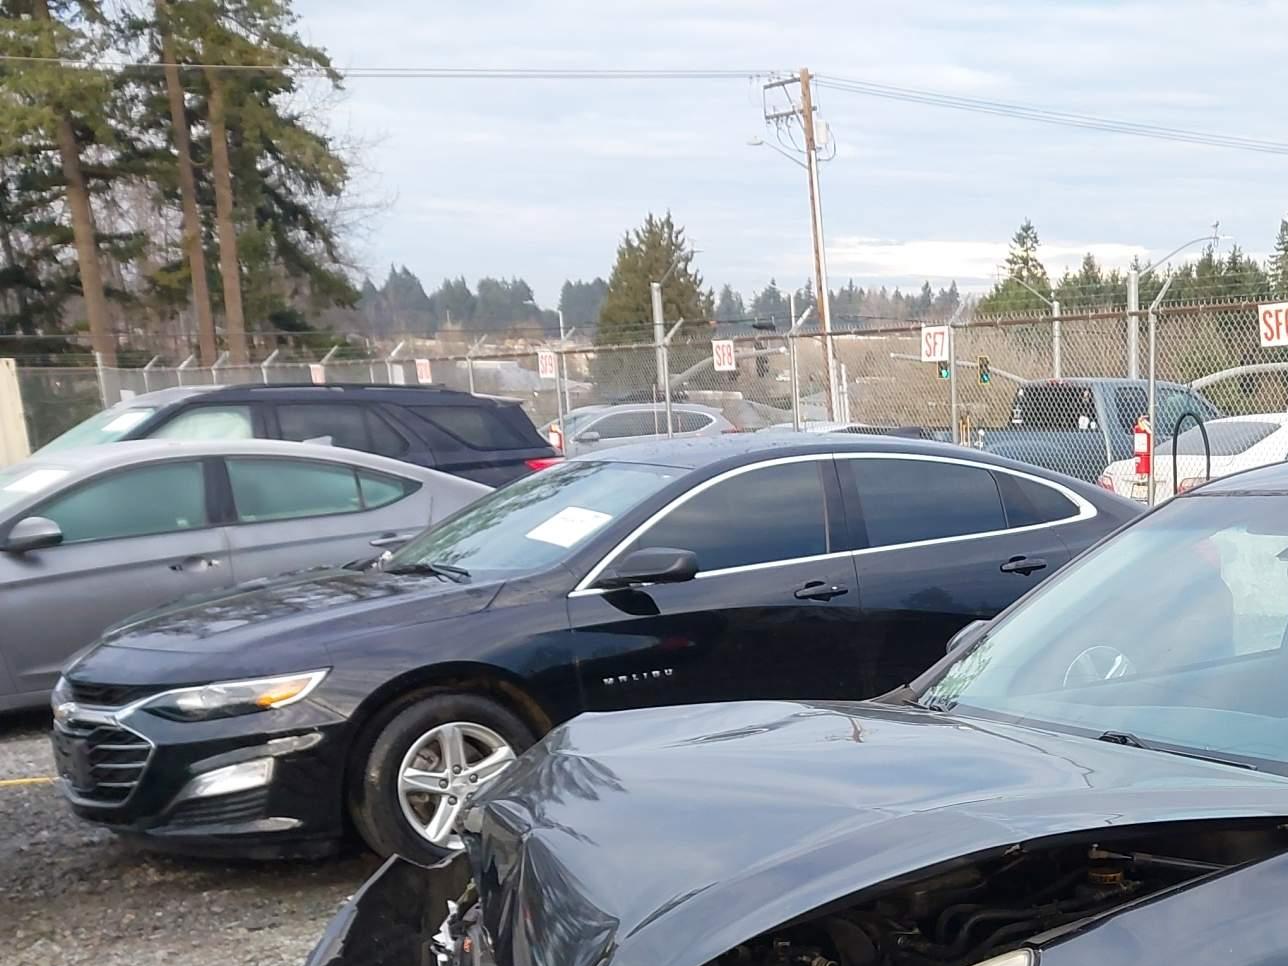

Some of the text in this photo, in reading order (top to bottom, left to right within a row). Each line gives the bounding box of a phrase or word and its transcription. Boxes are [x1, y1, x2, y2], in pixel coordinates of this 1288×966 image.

[715, 344, 734, 367] SF8
[925, 331, 945, 358] SF7
[602, 668, 673, 685] MALIBU
